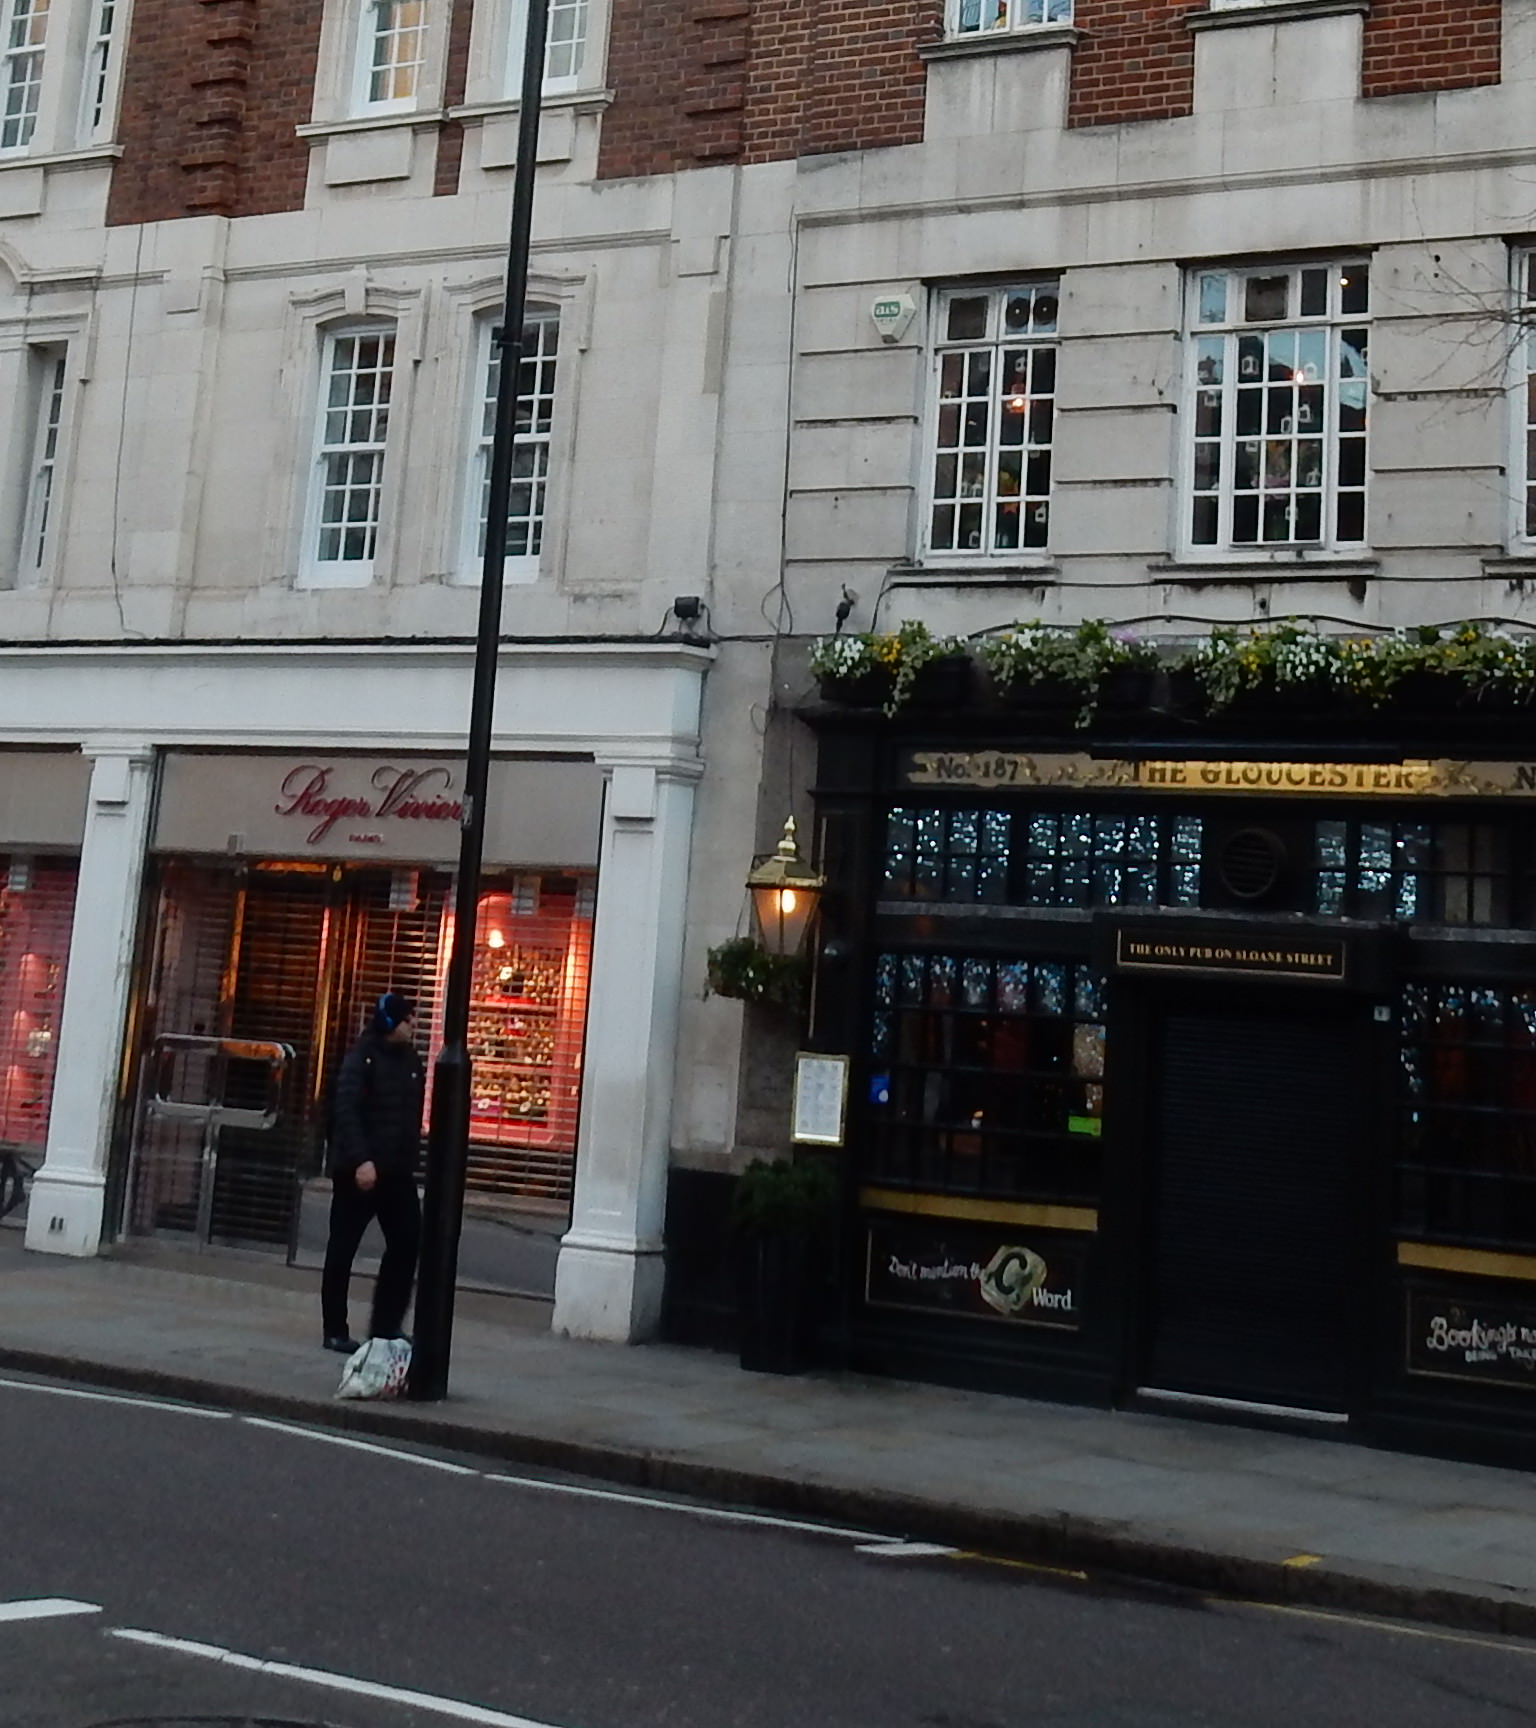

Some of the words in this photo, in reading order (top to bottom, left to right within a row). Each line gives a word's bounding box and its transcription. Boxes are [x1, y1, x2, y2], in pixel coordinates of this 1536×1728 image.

[978, 757, 1020, 781] 187
[1131, 760, 1187, 785] THE
[1199, 762, 1415, 789] GLOUCESTER
[275, 765, 371, 844] Roger
[371, 765, 463, 820] Vivier
[1129, 943, 1152, 956] THE
[1154, 945, 1185, 958] ONLY
[1189, 947, 1212, 959] PUB
[1215, 948, 1233, 960] ON
[1235, 950, 1282, 963] SLOANE
[1286, 953, 1333, 966] STREET
